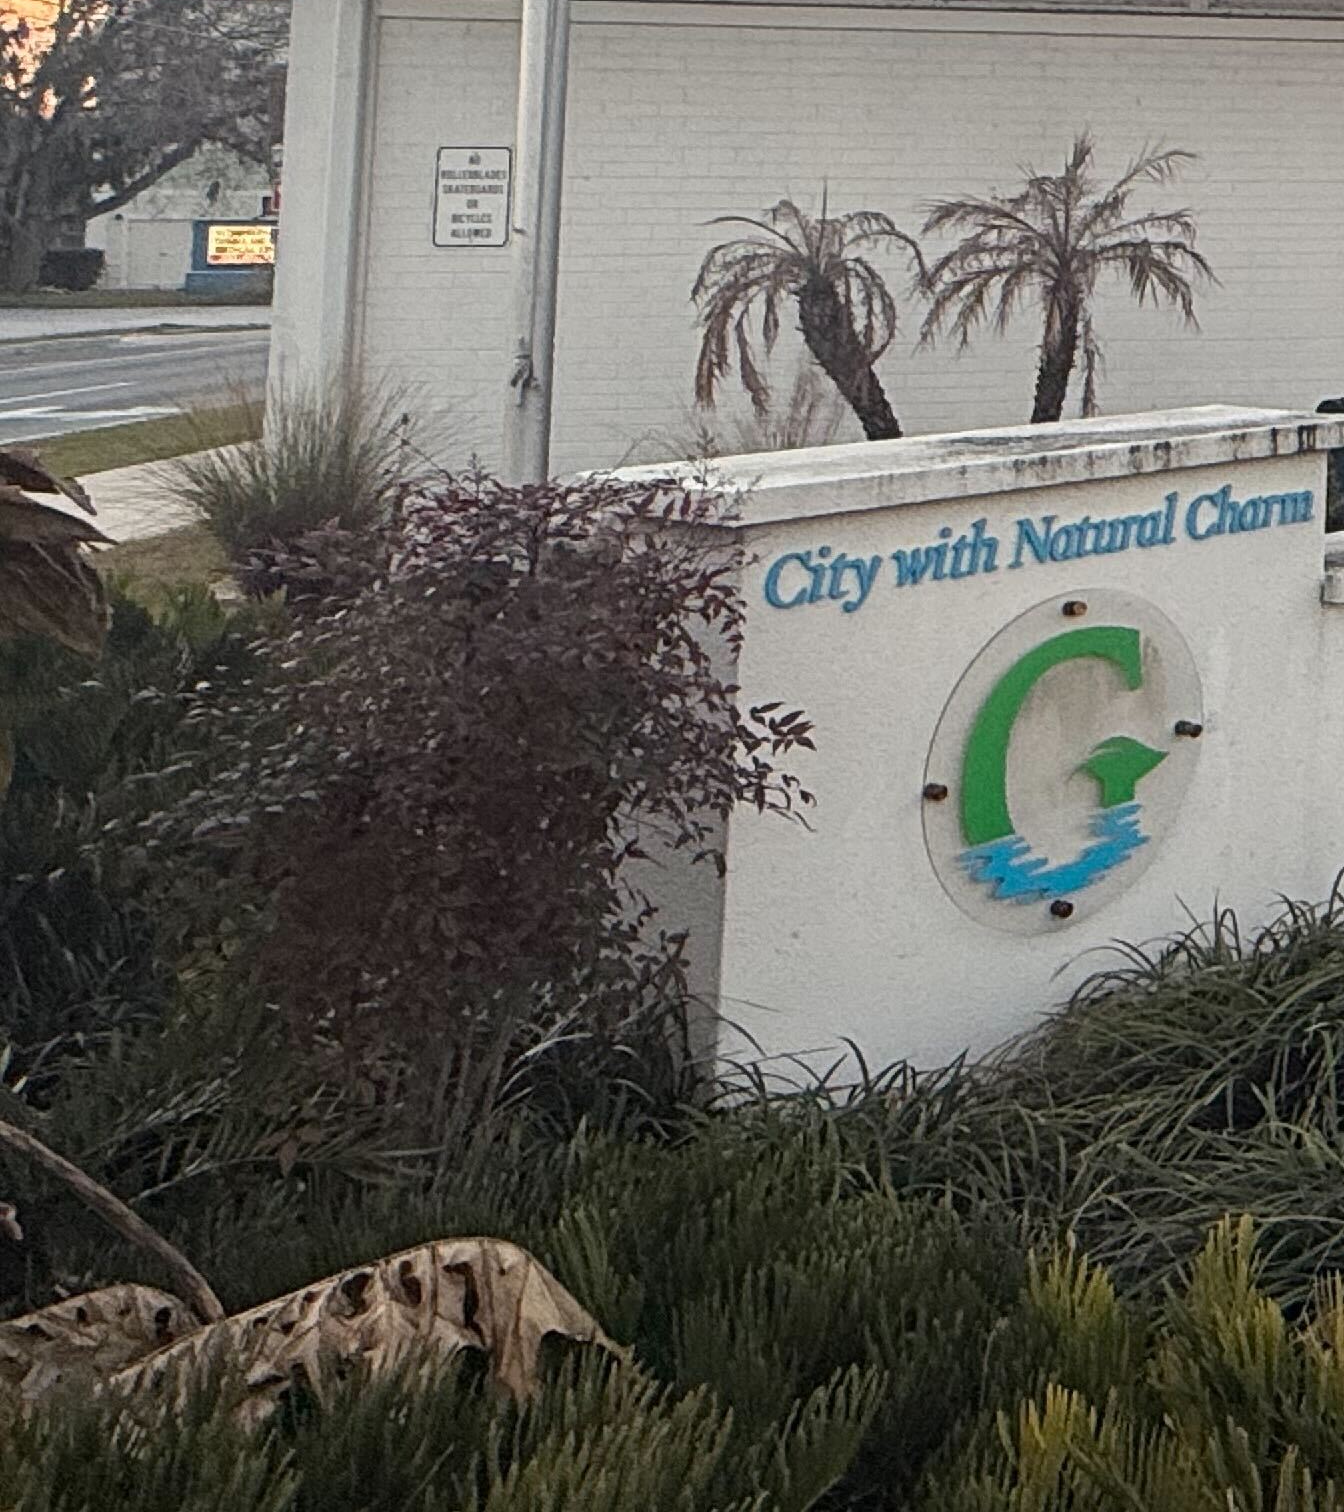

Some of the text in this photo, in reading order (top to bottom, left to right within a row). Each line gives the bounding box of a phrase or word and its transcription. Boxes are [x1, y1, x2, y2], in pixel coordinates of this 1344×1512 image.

[765, 484, 1315, 613] City with Natural Charm
[955, 626, 1169, 904] G
